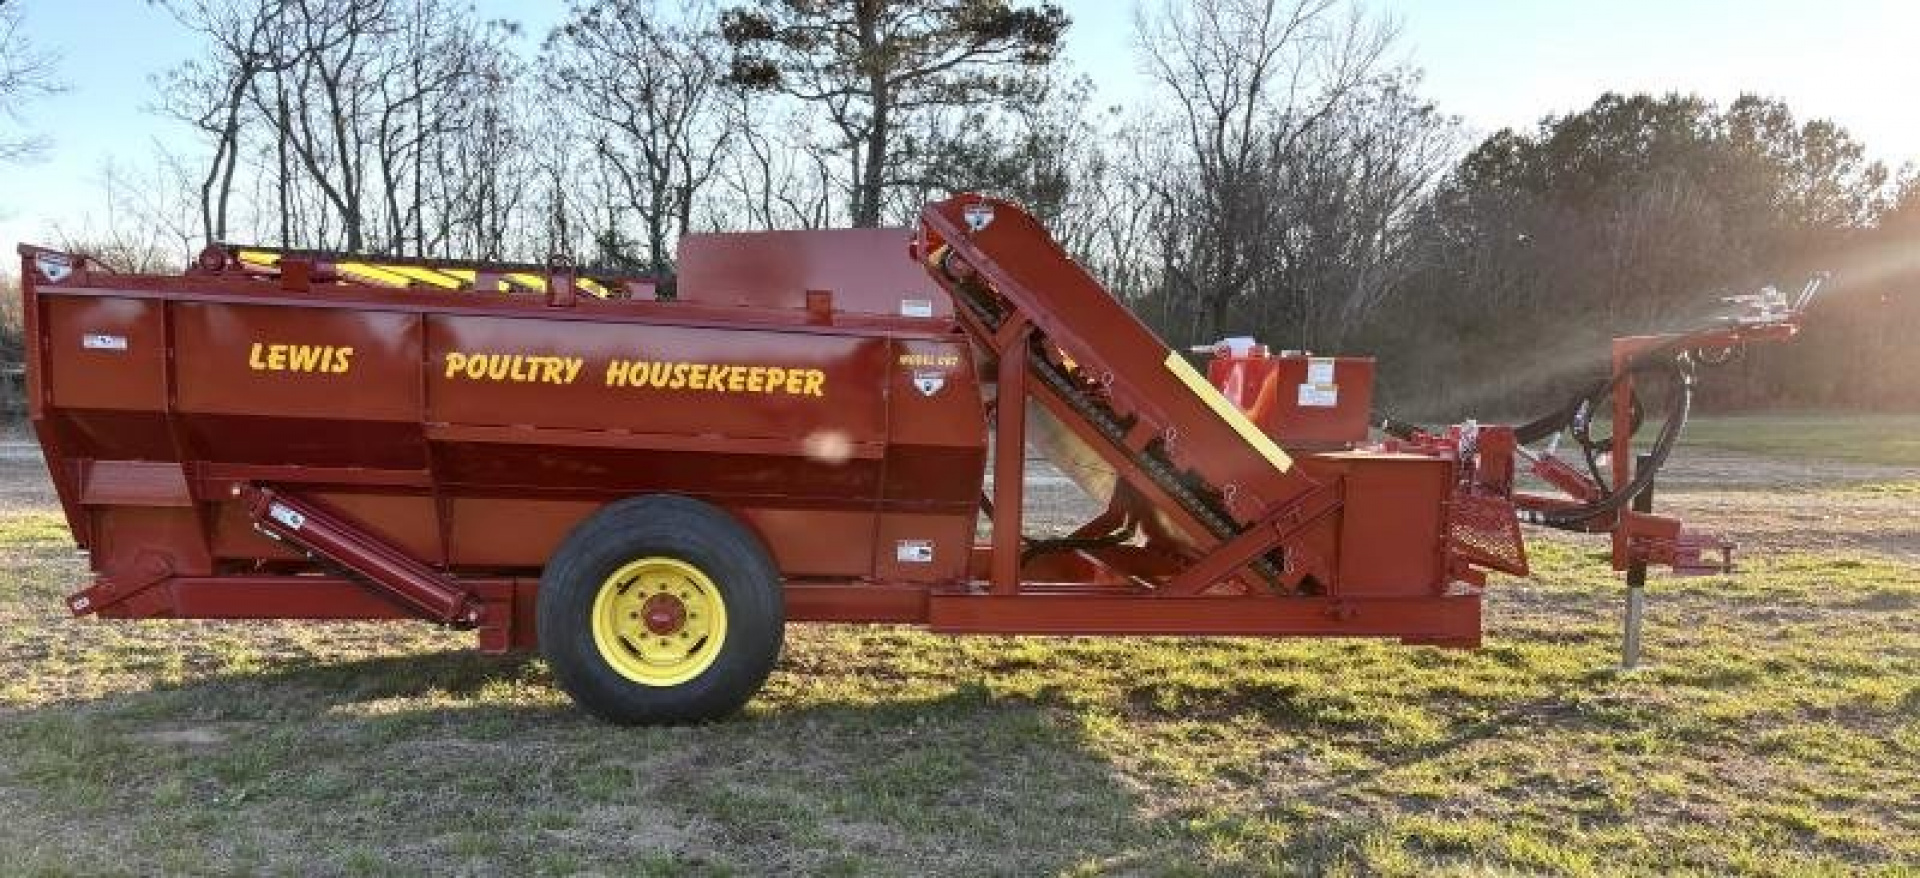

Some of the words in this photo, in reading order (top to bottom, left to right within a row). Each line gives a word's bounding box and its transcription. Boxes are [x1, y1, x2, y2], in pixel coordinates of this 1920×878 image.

[249, 342, 354, 373] LEWIS
[445, 352, 584, 385] POULTRY
[606, 359, 826, 396] HOUSEKEEPER
